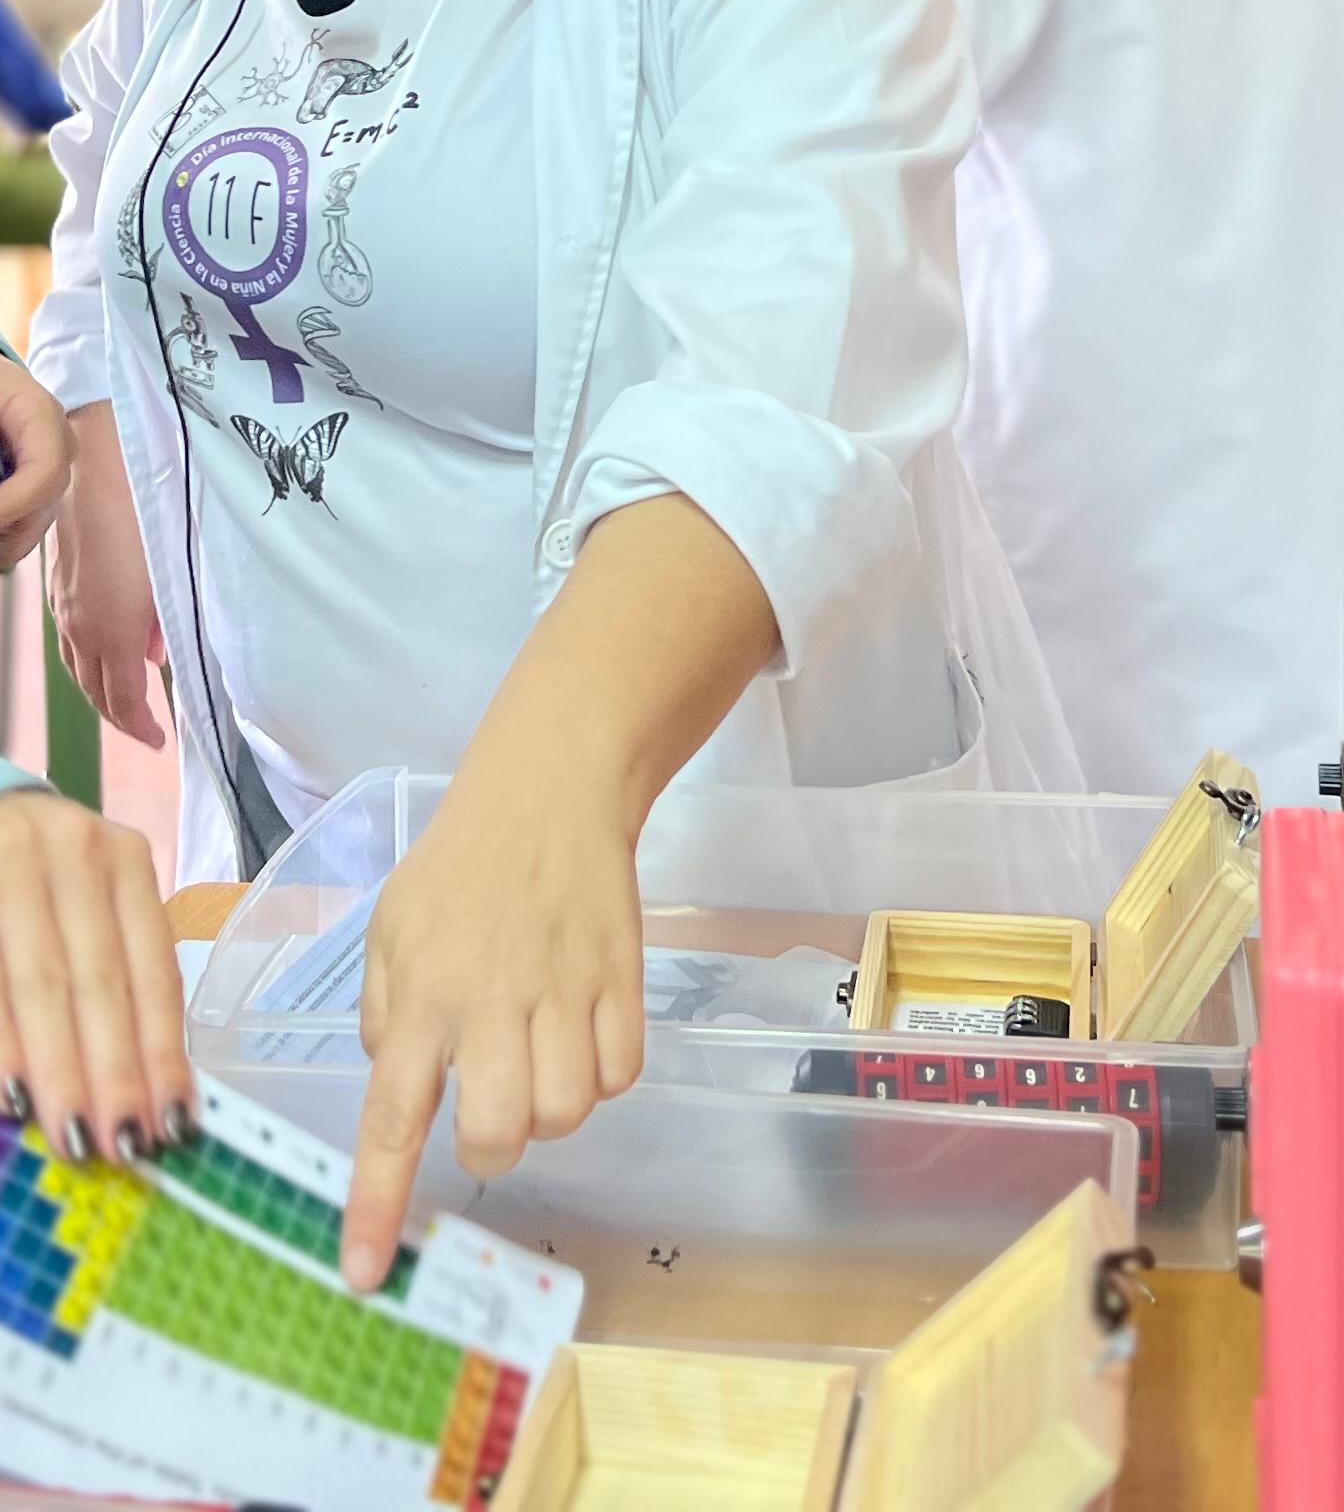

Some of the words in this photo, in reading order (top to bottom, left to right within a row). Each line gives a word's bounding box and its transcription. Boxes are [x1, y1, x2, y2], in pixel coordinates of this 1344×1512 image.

[191, 142, 217, 166] Día
[221, 131, 303, 167] Internacional
[288, 167, 302, 184] de
[286, 189, 296, 205] la
[208, 172, 236, 239] 11
[251, 180, 271, 244] F
[171, 203, 196, 265] Ciencia
[283, 212, 298, 257] Mujer
[195, 262, 206, 282] la
[276, 257, 288, 274] y
[210, 275, 228, 290] en
[266, 271, 282, 286] la
[231, 280, 266, 297] Niña
[1026, 1068, 1036, 1085] 6
[1075, 1067, 1086, 1082] 2
[1130, 1088, 1139, 1108] 7
